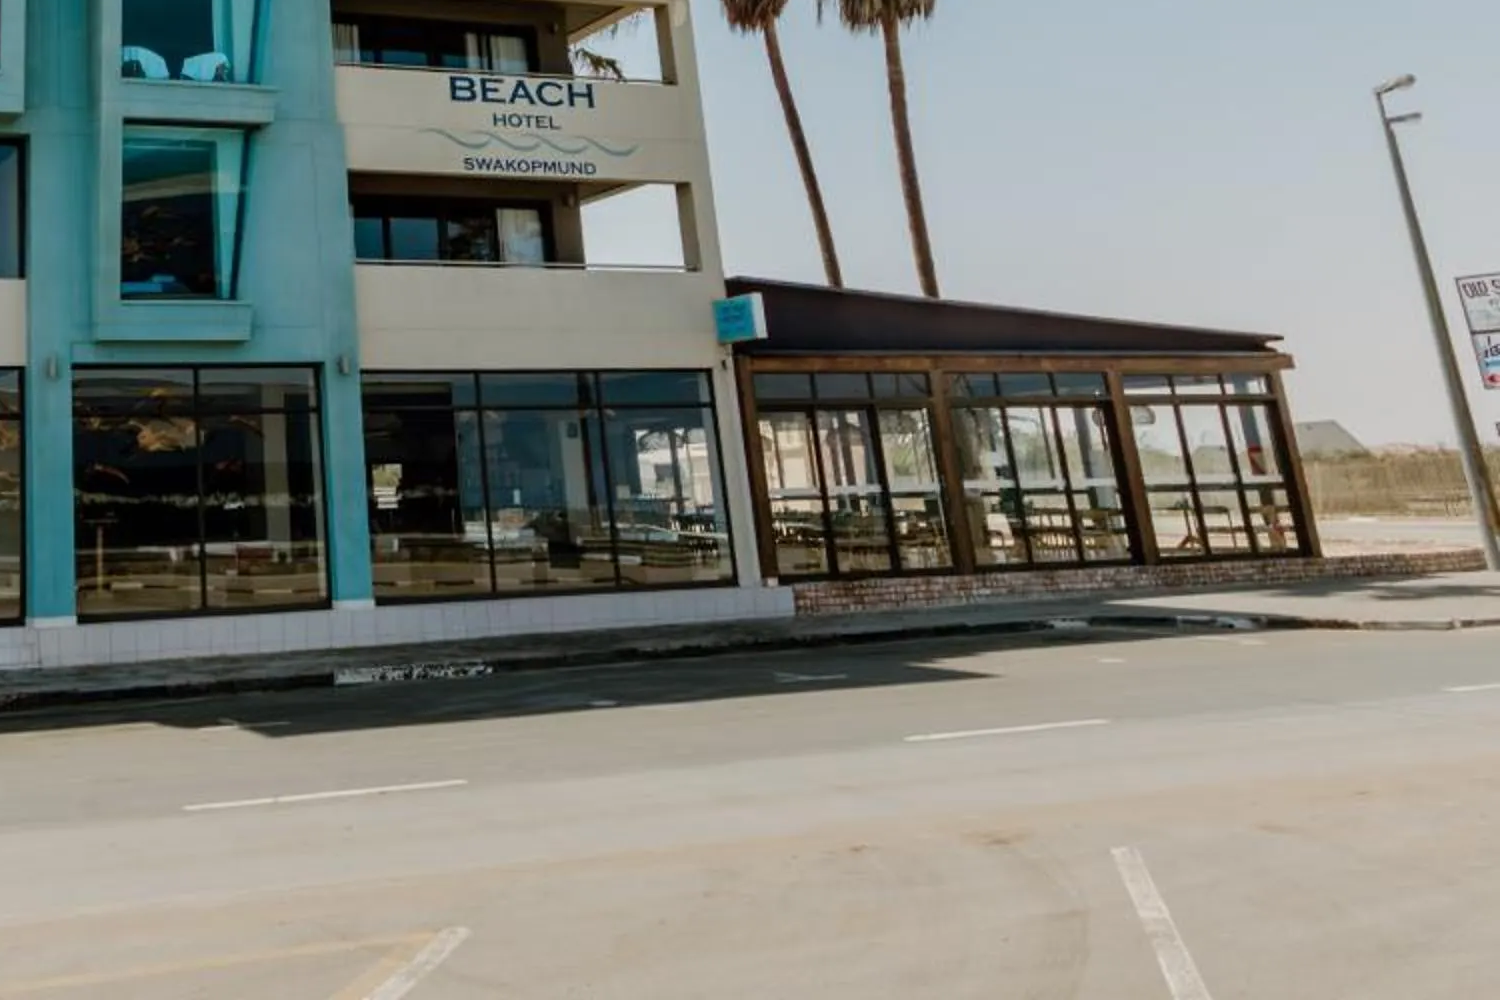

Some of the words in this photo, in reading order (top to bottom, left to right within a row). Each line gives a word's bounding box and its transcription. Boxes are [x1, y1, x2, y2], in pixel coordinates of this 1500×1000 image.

[450, 76, 596, 109] BEACH
[492, 112, 562, 131] HOTEL
[463, 157, 596, 176] SWAKOPMUND
